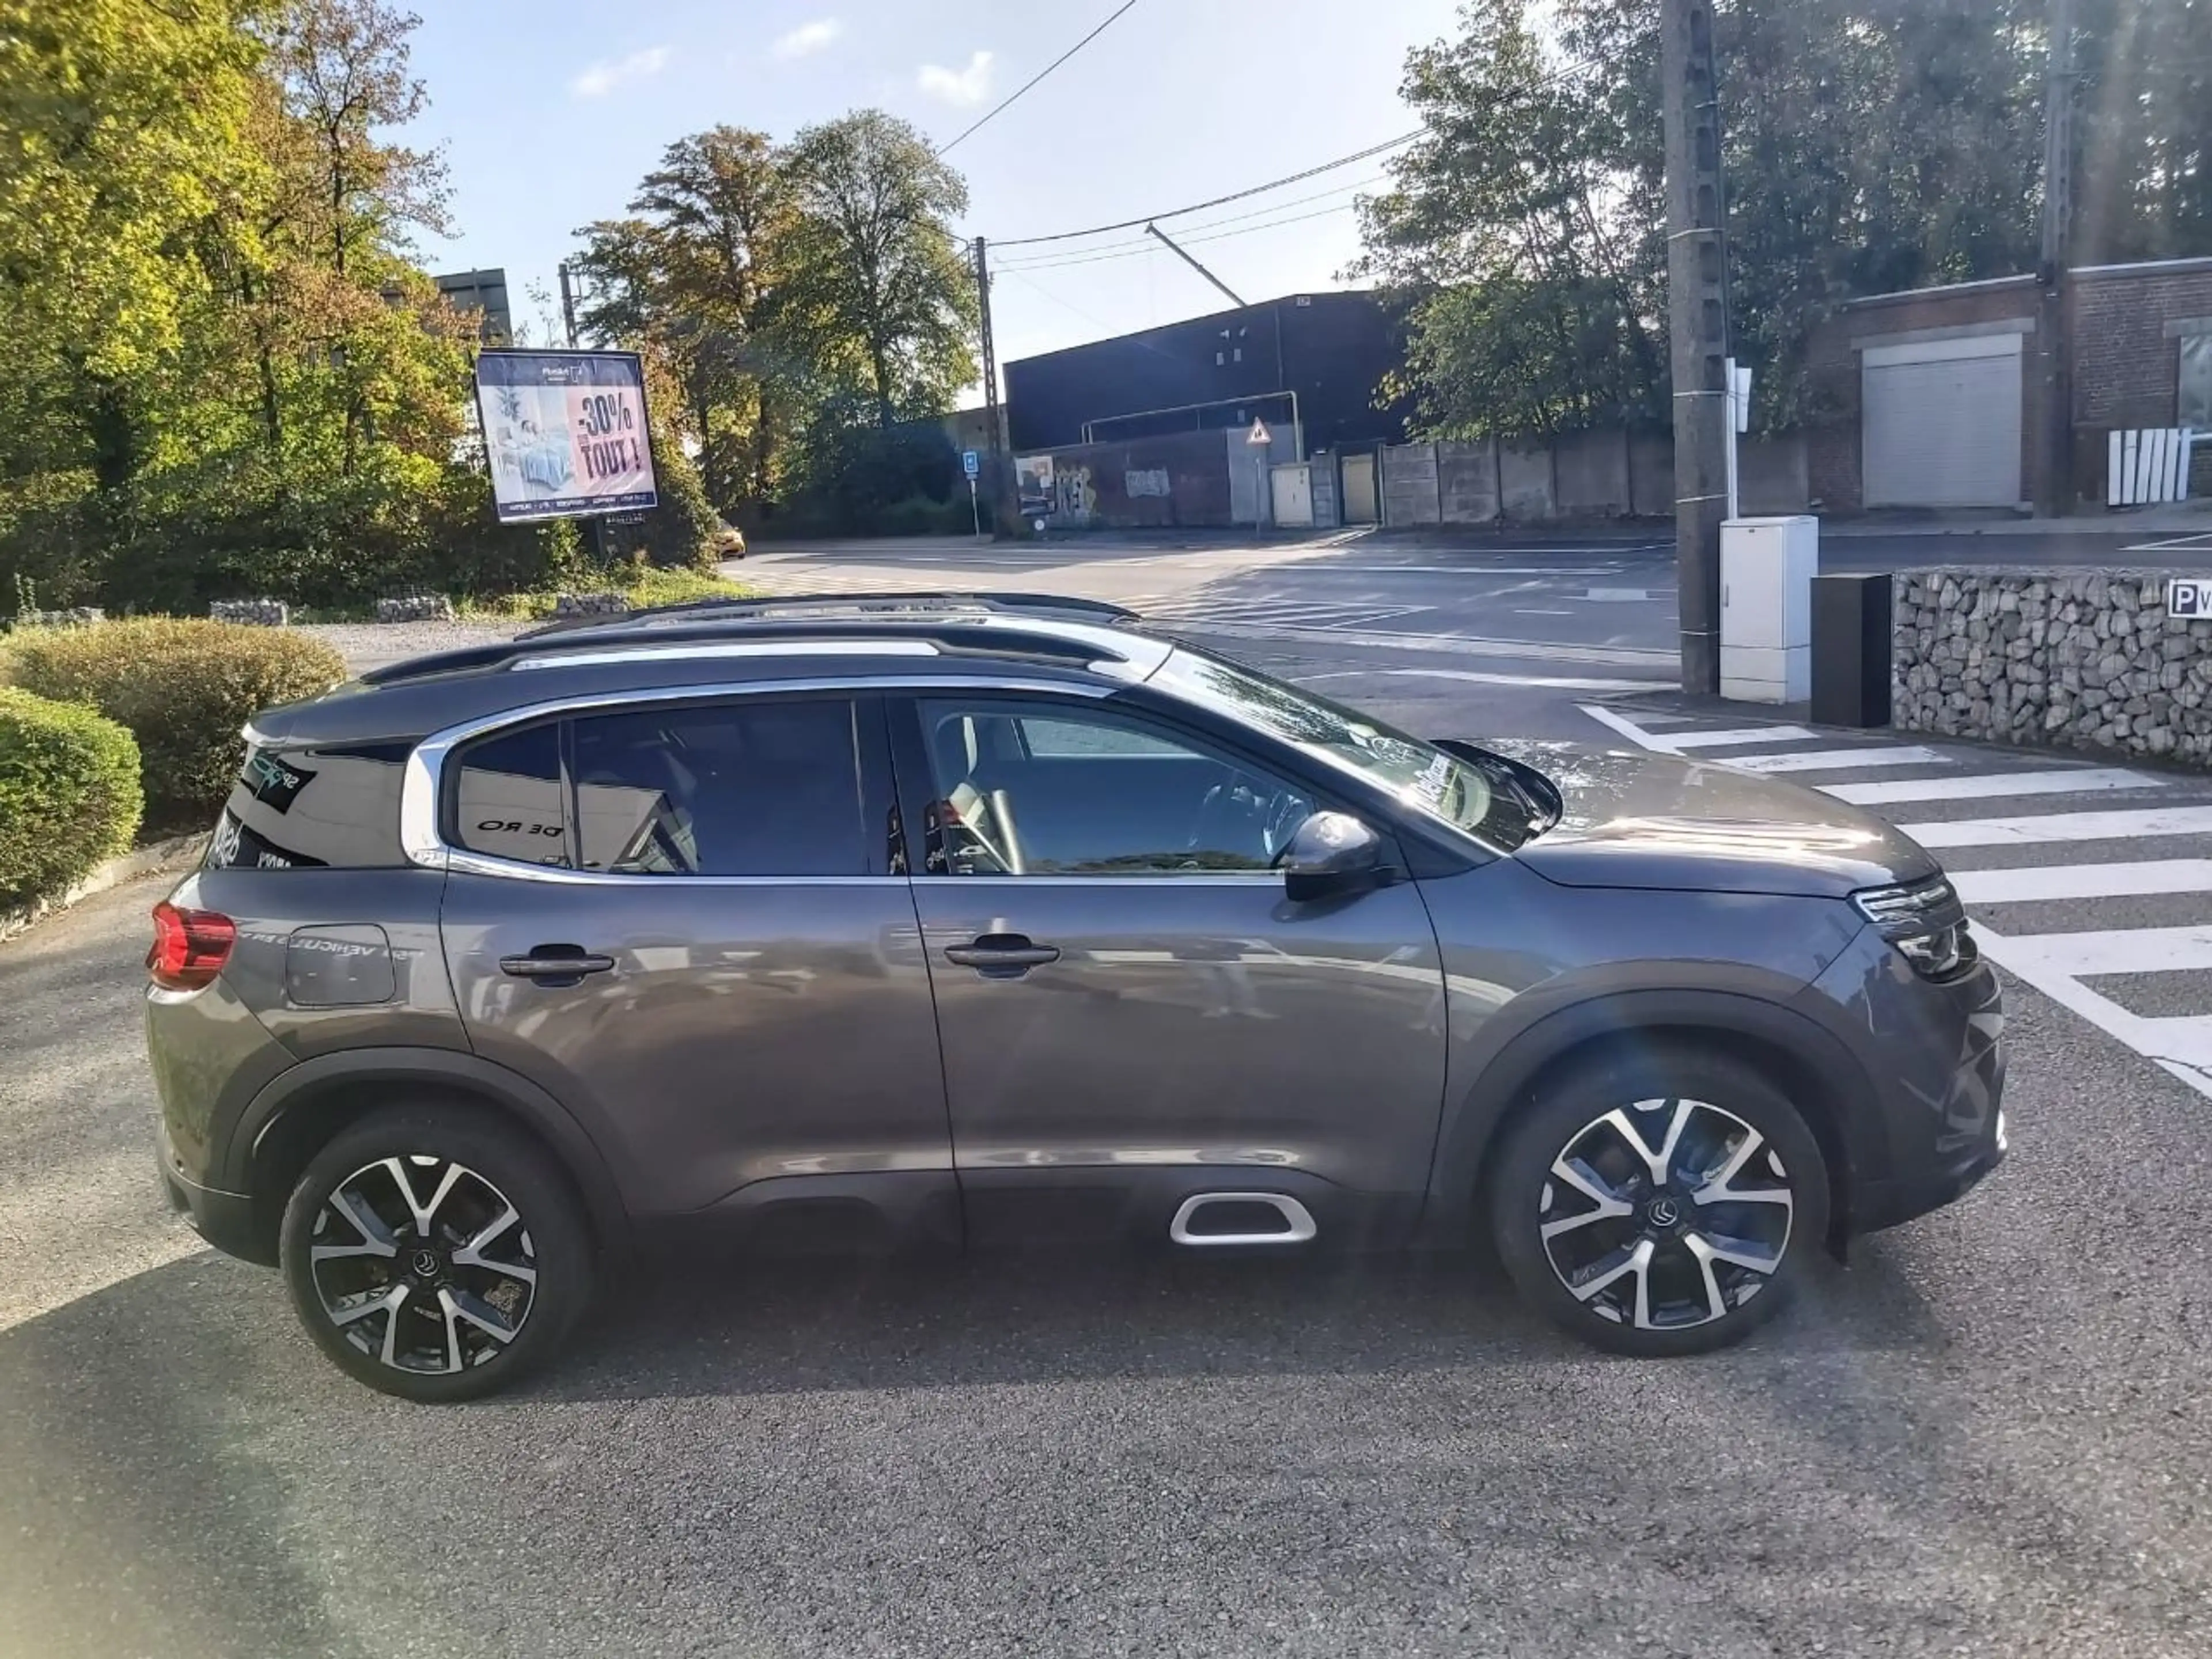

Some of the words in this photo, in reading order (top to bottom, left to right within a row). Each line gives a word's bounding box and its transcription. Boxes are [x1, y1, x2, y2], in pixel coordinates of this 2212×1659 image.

[578, 392, 632, 436] -30%
[581, 439, 627, 479] TOUT
[2175, 586, 2194, 612] P
[2200, 591, 2212, 612] V
